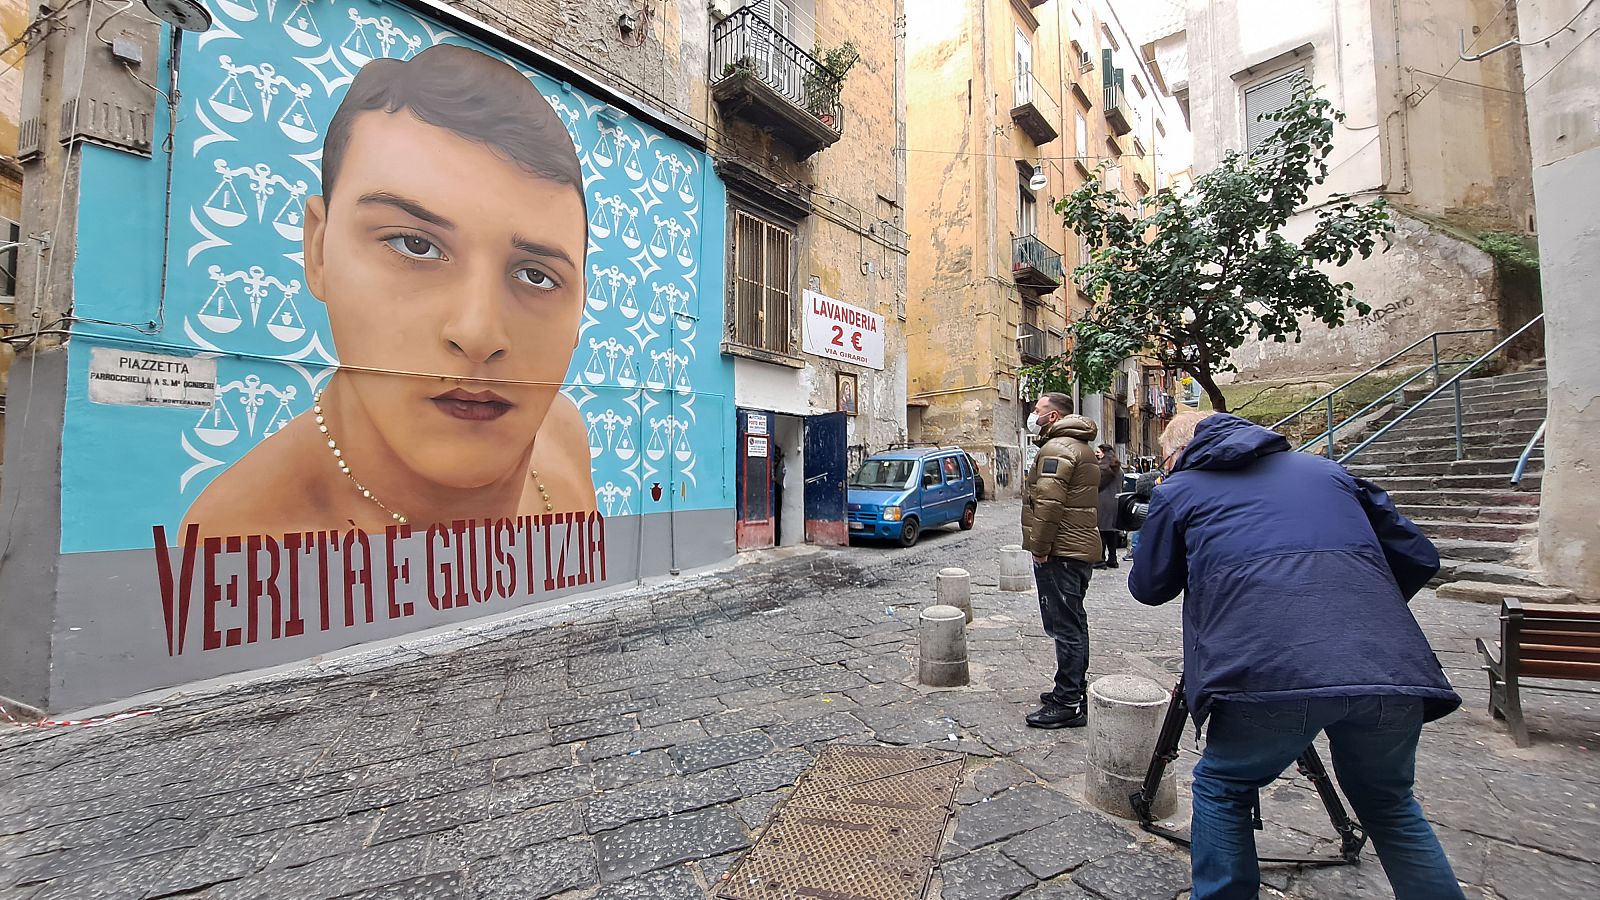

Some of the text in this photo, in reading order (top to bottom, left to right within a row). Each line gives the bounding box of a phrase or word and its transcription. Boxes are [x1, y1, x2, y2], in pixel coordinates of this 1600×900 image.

[813, 297, 877, 333] LAVANDERIA
[831, 325, 862, 352] 2 €
[119, 357, 189, 374] PIAZZETTA
[824, 347, 868, 363] VIA GIRARDI
[90, 372, 151, 385] PARROCCHIELLA
[152, 509, 607, 656] VERITÀ E GIUSTIZIA
